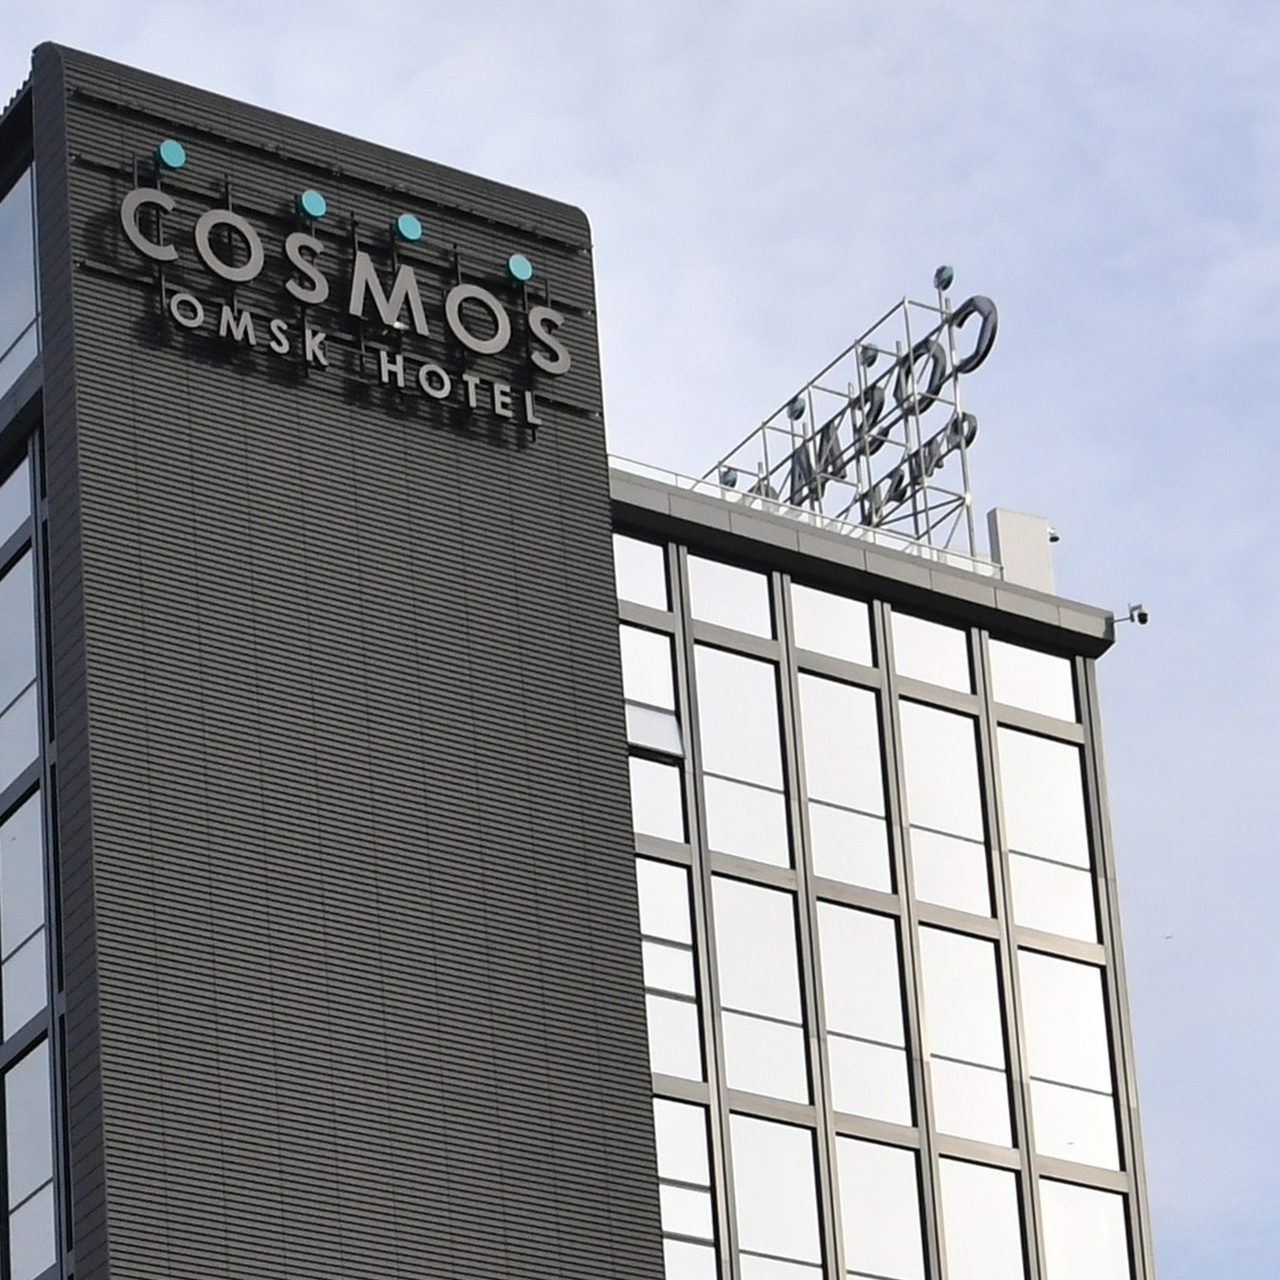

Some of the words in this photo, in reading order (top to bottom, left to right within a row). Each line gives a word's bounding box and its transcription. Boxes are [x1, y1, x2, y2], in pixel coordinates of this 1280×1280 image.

[120, 187, 572, 376] COSMOS
[169, 292, 329, 368] OMSK
[380, 350, 543, 427] HOTEL
